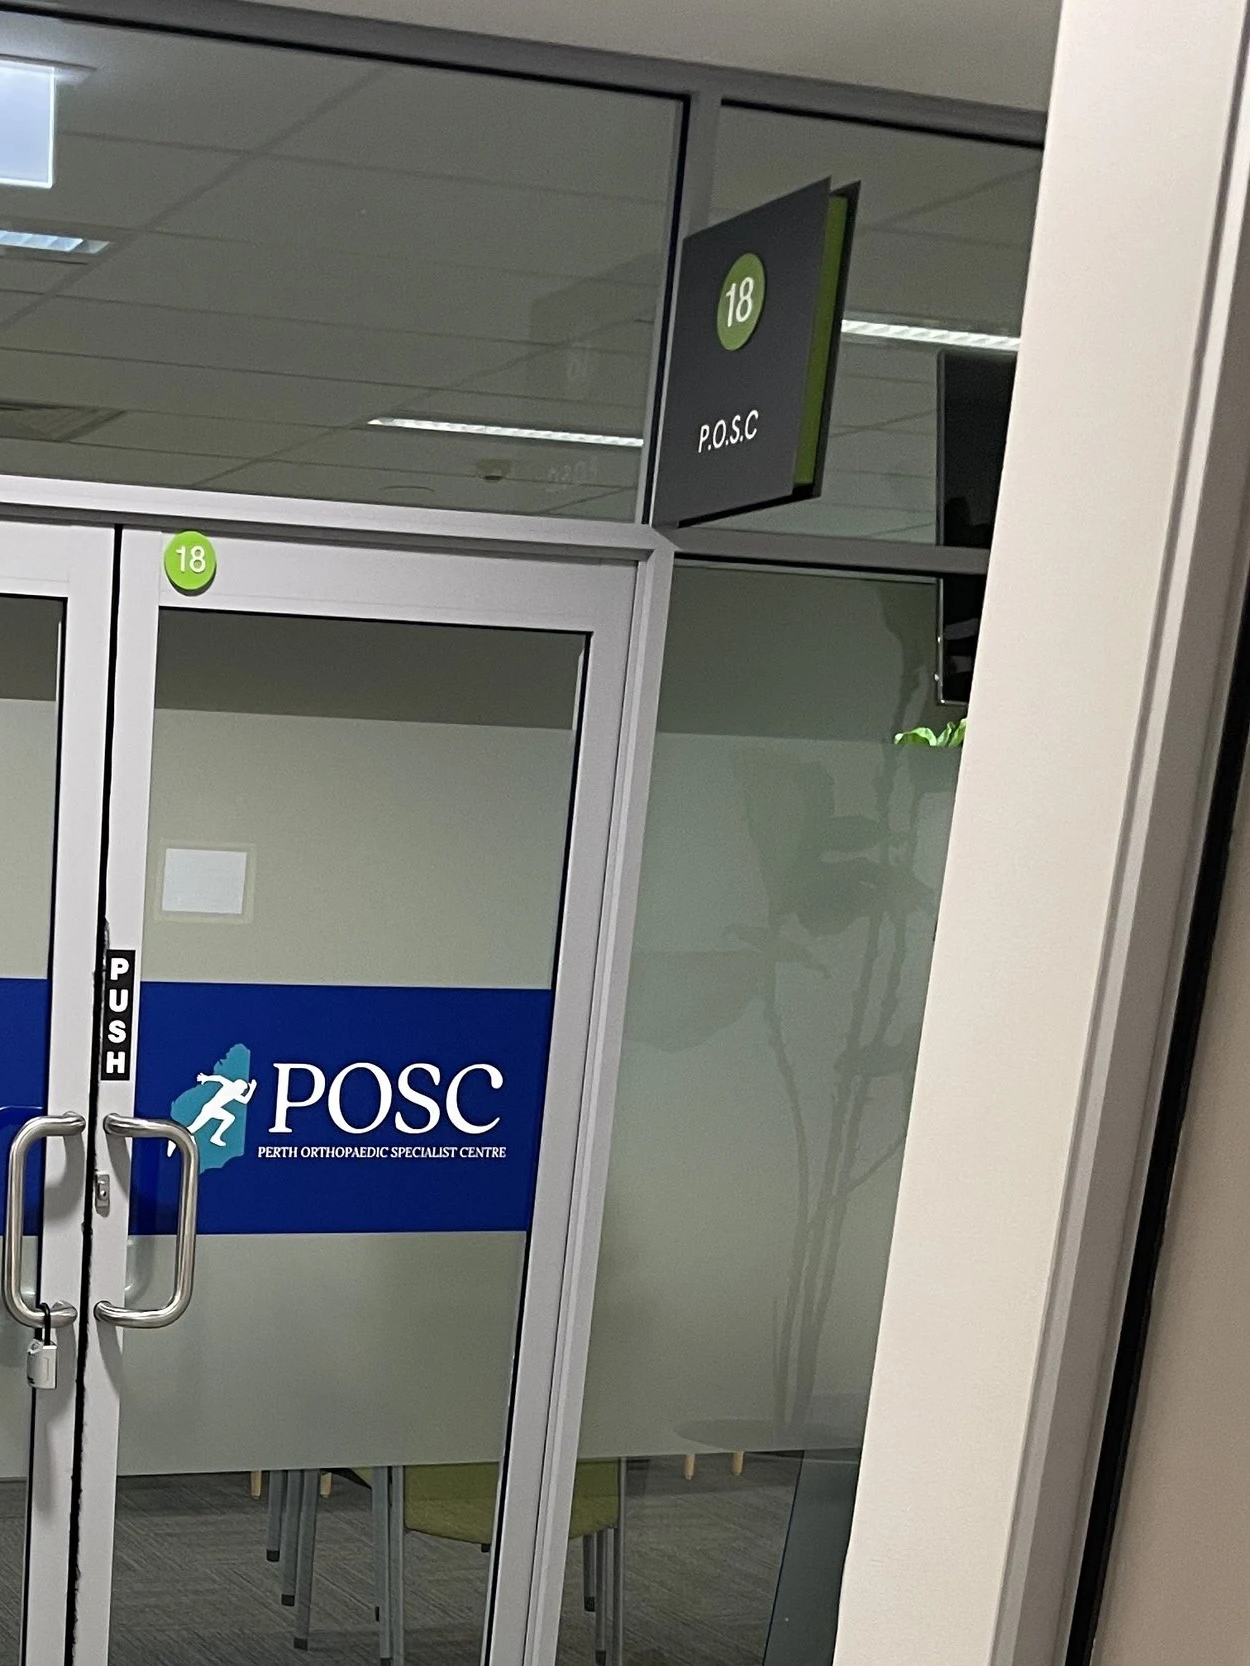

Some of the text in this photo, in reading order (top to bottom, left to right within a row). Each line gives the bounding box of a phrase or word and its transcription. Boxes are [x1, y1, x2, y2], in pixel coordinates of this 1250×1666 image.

[726, 277, 754, 327] 18
[698, 410, 758, 453] P.O.S.C
[177, 546, 205, 572] 18
[106, 957, 129, 1074] PUSH
[269, 1063, 503, 1134] POSC
[258, 1146, 506, 1158] PERTH ORTHOPAEDIC SPECIALIST CENTRE
